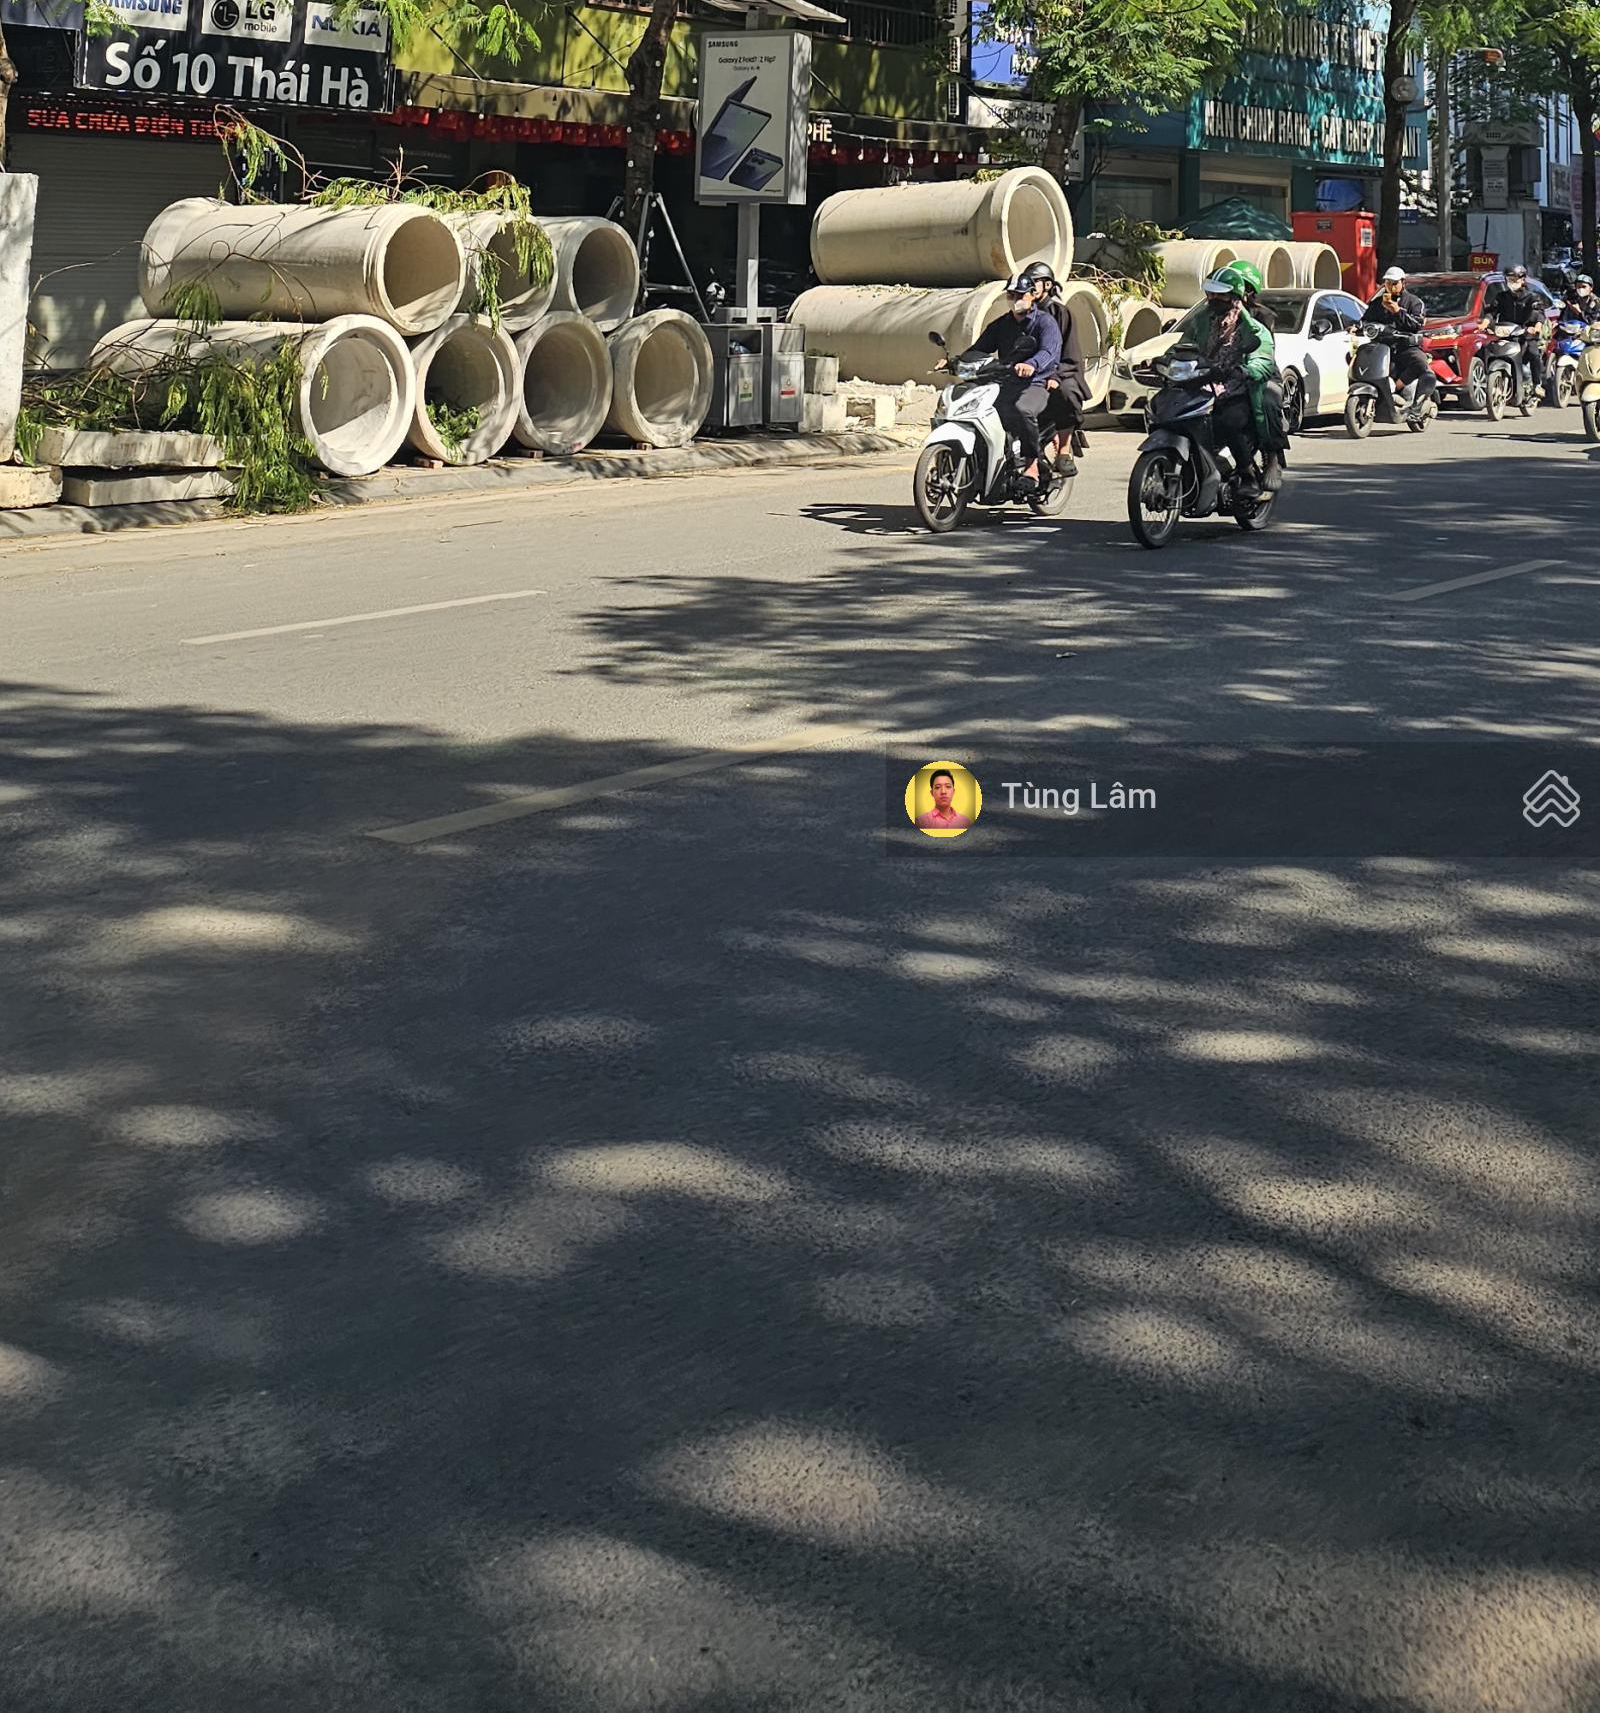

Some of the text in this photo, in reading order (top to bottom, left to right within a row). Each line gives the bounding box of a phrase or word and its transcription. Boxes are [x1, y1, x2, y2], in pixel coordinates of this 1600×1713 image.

[245, 0, 276, 21] LG
[244, 22, 278, 34] mobile
[708, 40, 738, 48] SAMSUNG
[105, 39, 369, 109] Số 10 Thái Hà
